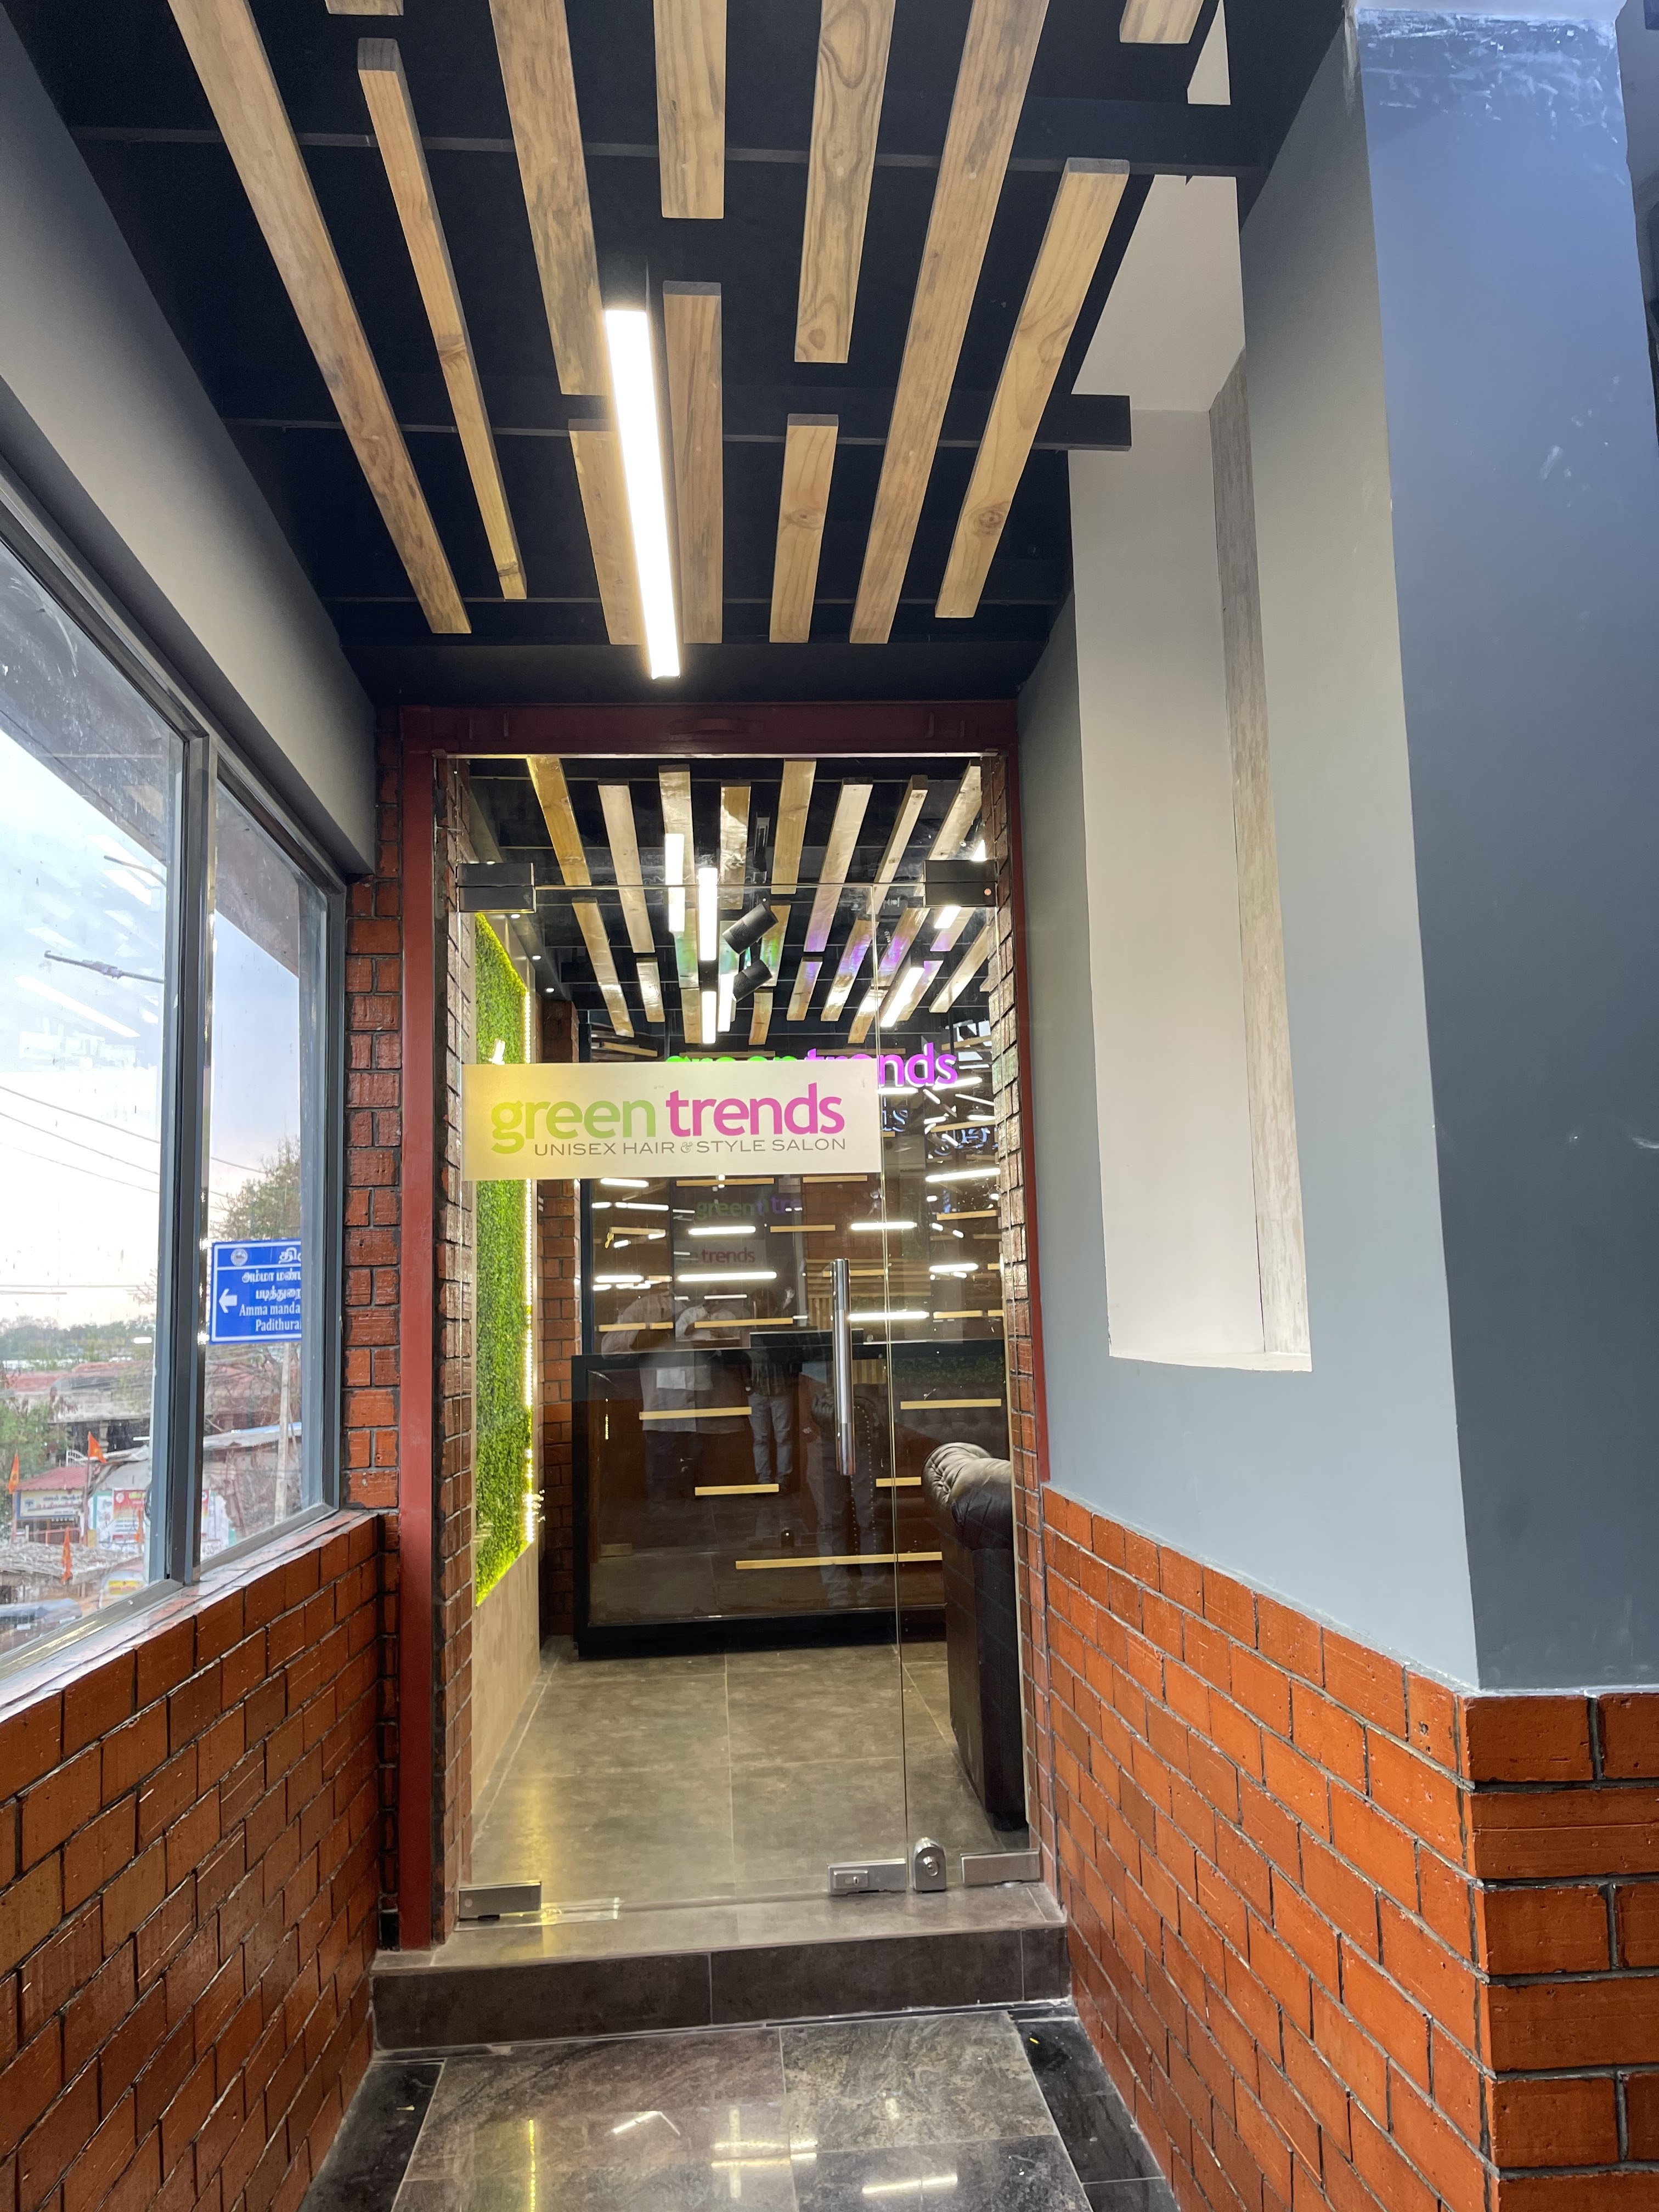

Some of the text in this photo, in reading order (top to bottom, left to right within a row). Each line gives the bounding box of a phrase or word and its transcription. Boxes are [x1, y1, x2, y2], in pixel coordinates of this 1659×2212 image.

[491, 1099, 656, 1154] green
[665, 1082, 845, 1137] trends
[534, 1138, 846, 1156] UNISEX HAIR & STYLE SALON
[701, 1246, 756, 1263] trends
[241, 1269, 275, 1283] அம்மா
[239, 1304, 268, 1317] Amma
